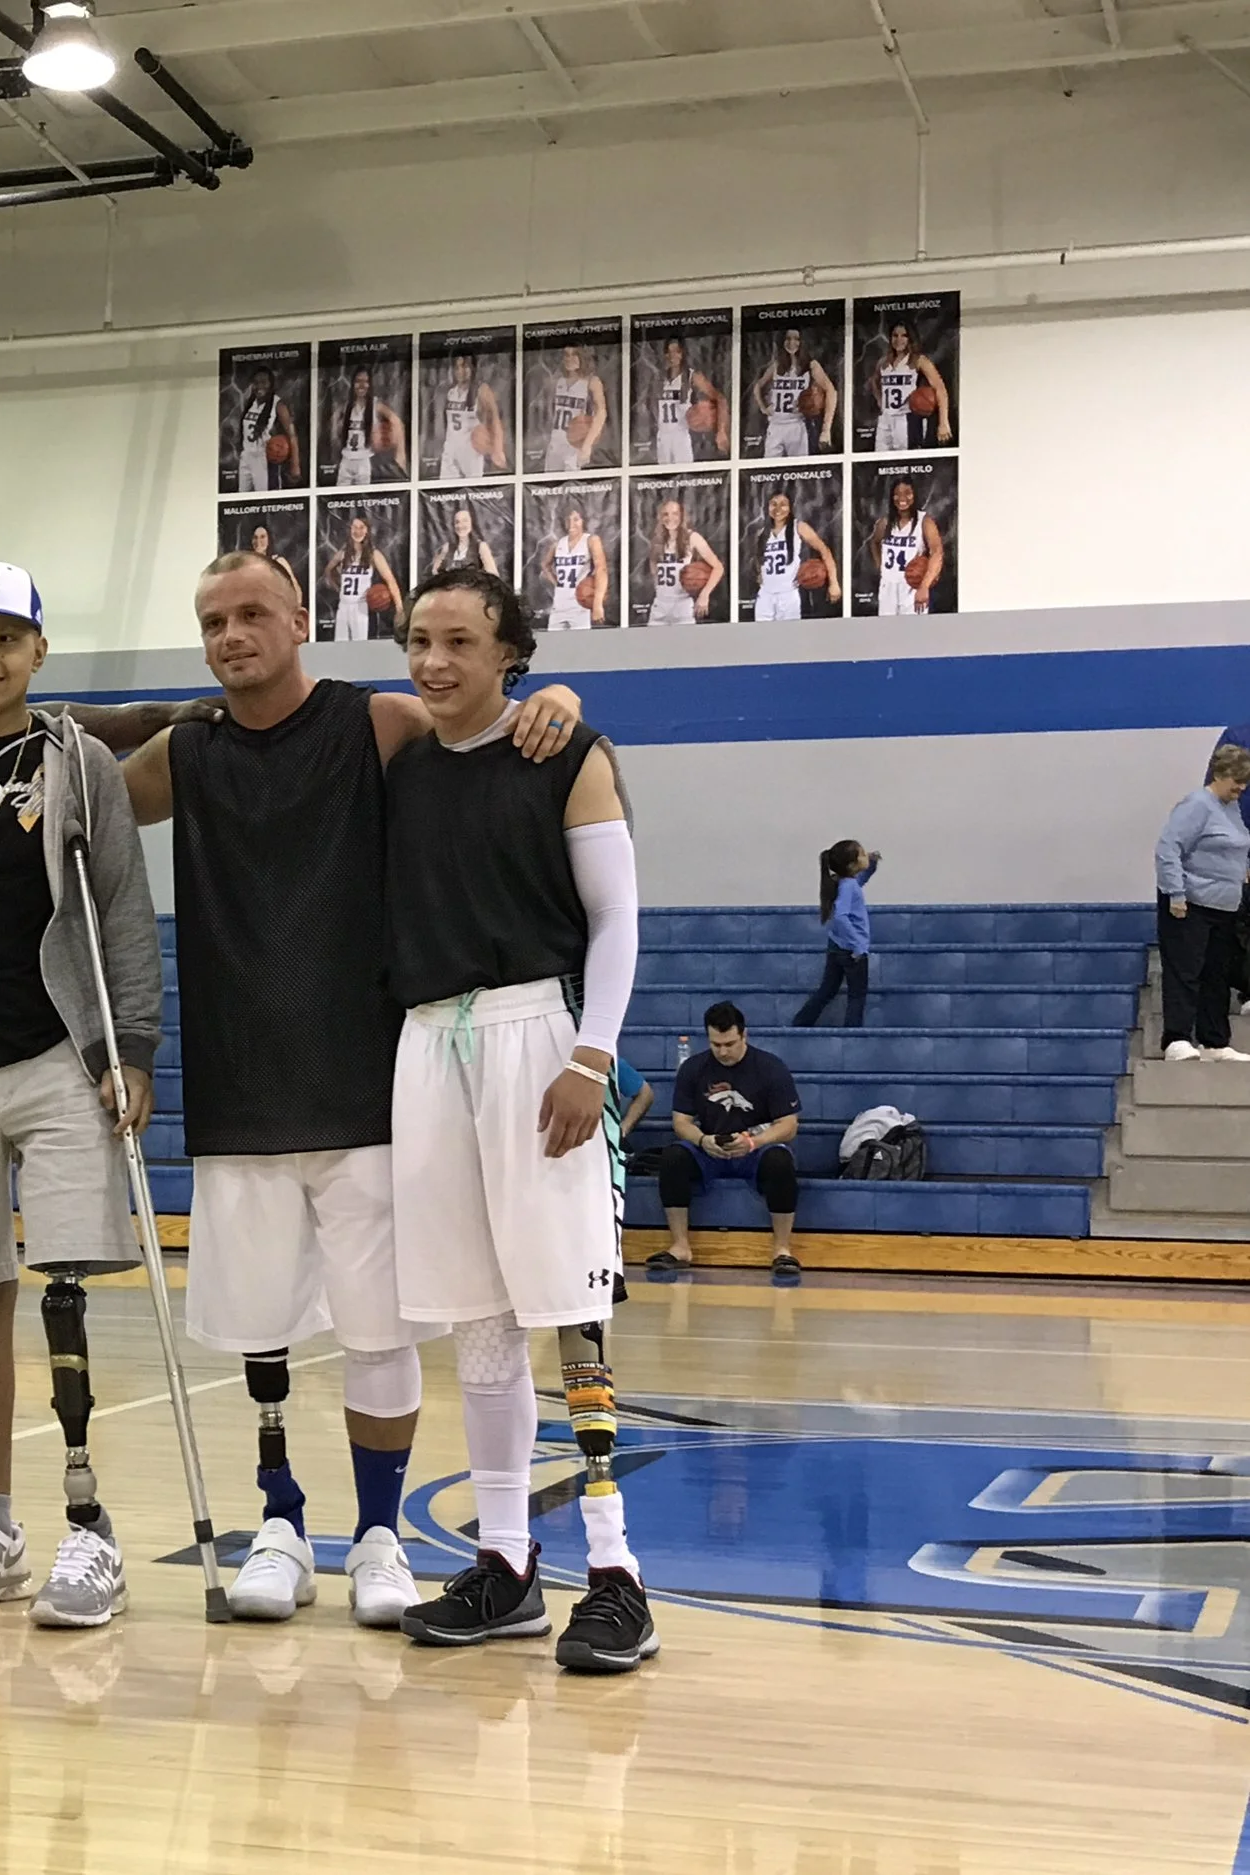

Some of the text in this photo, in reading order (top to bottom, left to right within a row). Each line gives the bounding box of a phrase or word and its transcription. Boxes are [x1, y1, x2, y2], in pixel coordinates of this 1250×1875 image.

[758, 306, 827, 320] CHLOE HADLEY
[874, 302, 905, 312] NAYELI
[681, 314, 729, 326] SANDOVAL
[775, 392, 794, 413] 12
[884, 388, 903, 410] 13
[452, 413, 462, 431] 5
[554, 409, 573, 430] 10
[662, 403, 678, 423] 11
[247, 424, 258, 442] 3
[750, 470, 832, 483] NENCY GONZALES
[878, 464, 933, 475] MISSIE KILO
[531, 484, 612, 496] KAYLEE FREEDMAN
[637, 477, 723, 490] BROOKE HINERMAN
[327, 498, 400, 509] GRACE STEPHENS
[467, 491, 503, 500] THOMAS
[224, 503, 304, 515] MALLORY STEPHENS
[763, 553, 785, 575] 32
[885, 549, 907, 571] 34
[557, 568, 577, 588] 24
[658, 566, 676, 587] 25
[343, 577, 359, 595] 21
